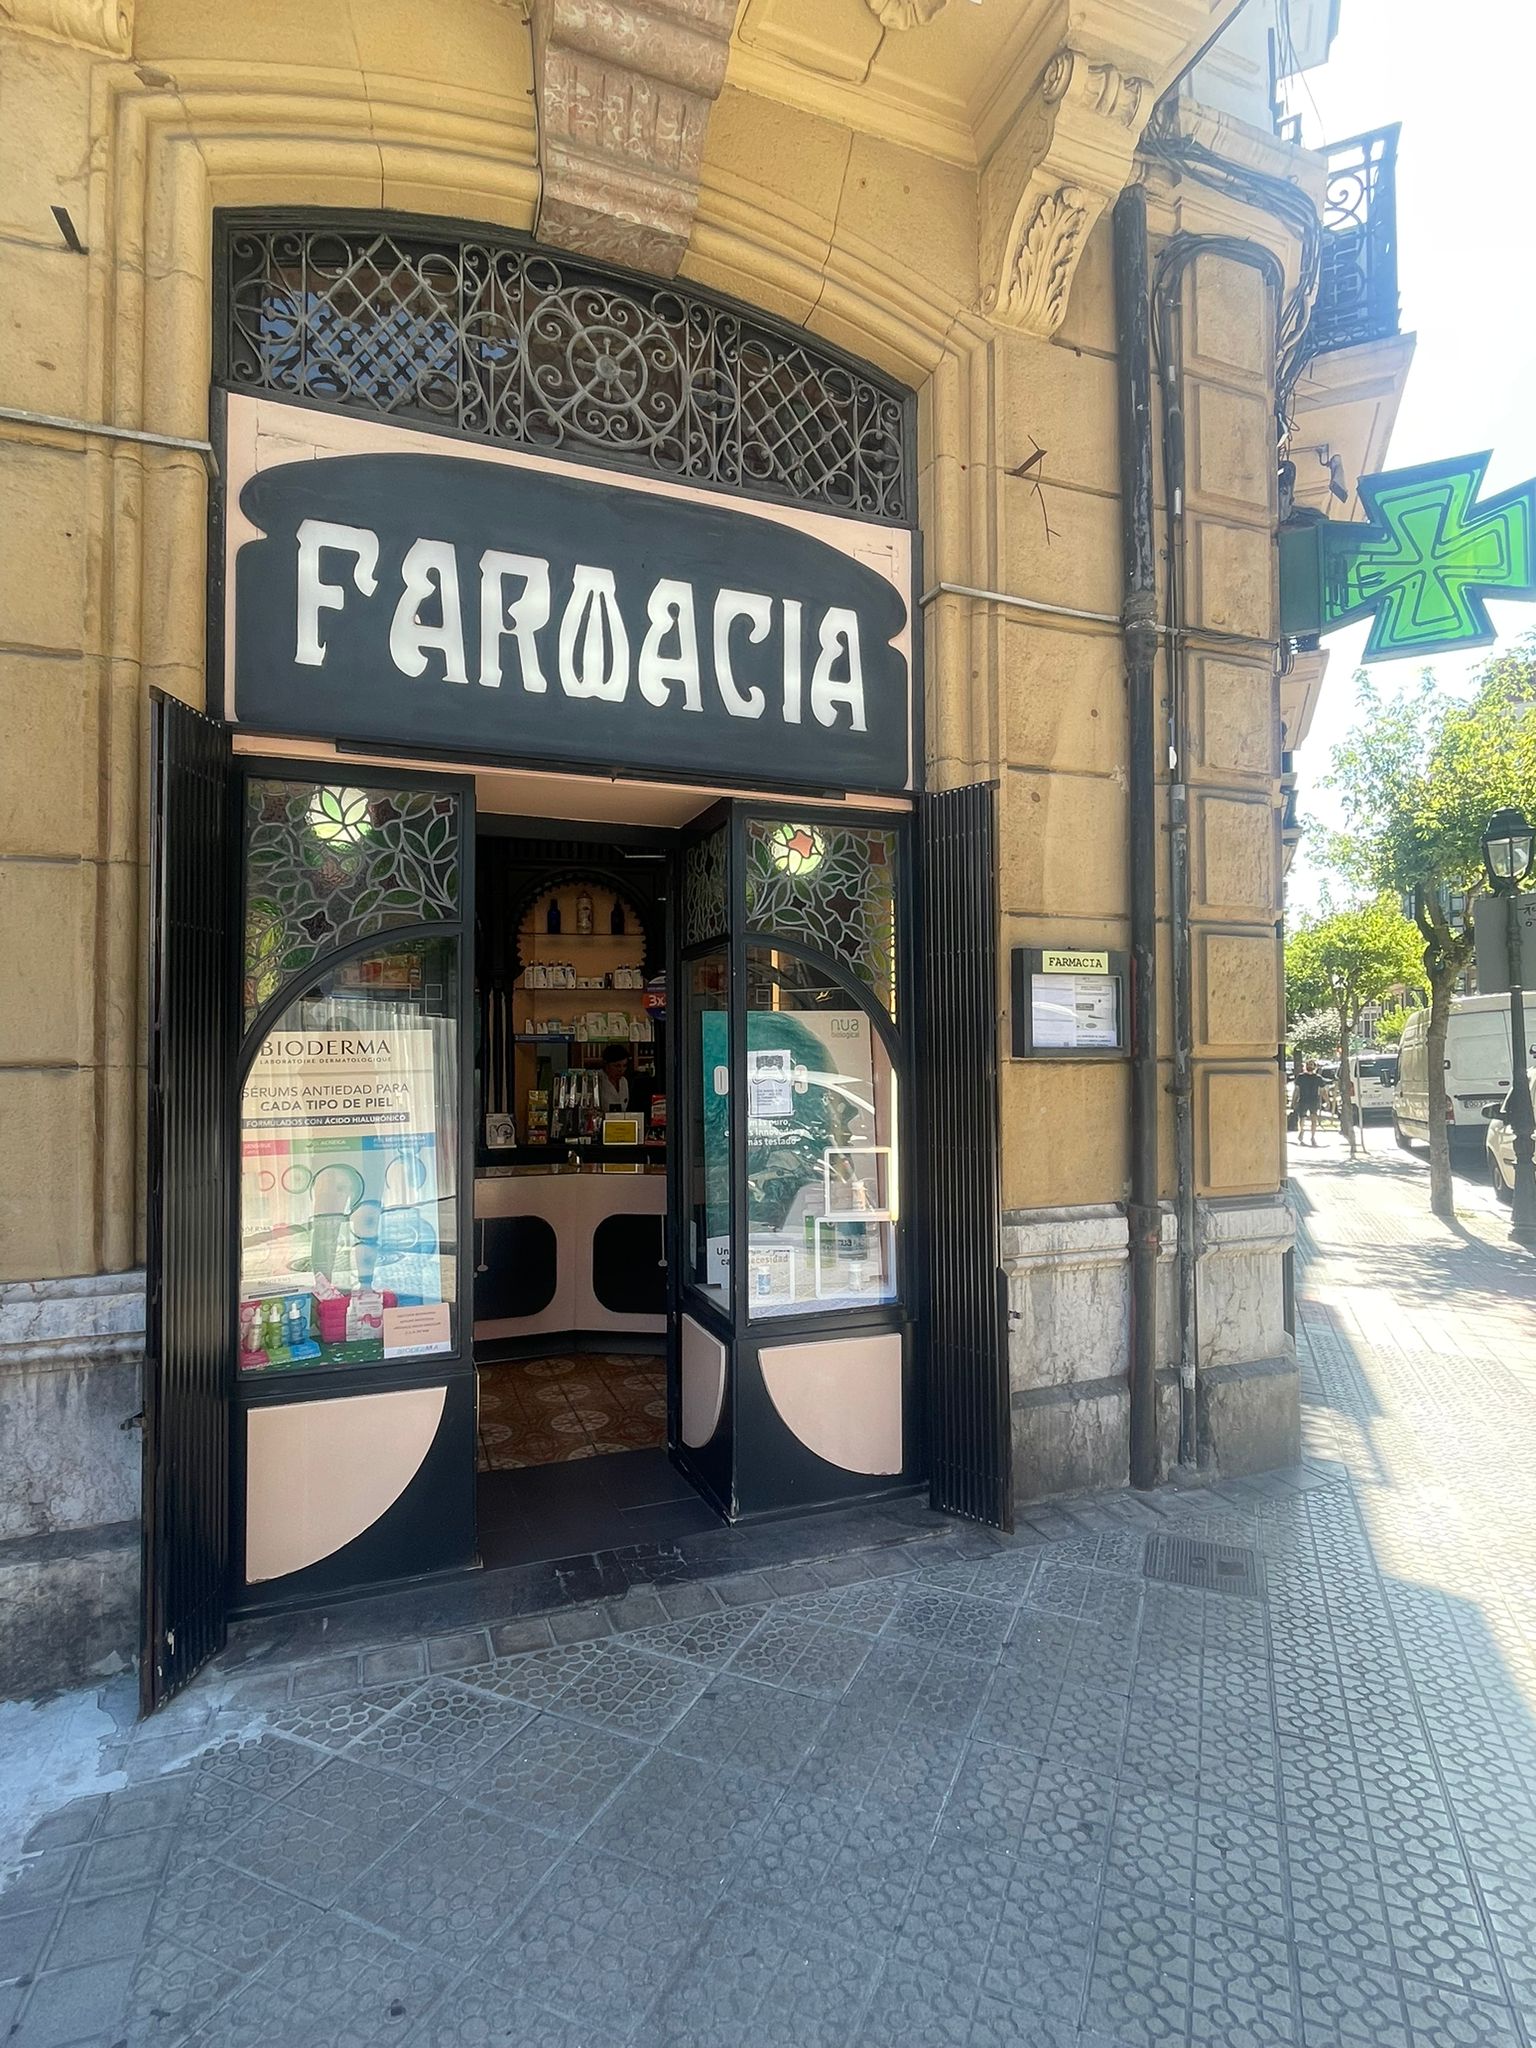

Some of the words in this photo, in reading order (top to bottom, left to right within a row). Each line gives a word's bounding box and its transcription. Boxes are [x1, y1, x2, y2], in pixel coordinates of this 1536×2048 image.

[295, 519, 868, 733] FARMACIA
[1049, 957, 1103, 968] FARMACIA
[831, 1018, 859, 1032] nua
[261, 1040, 391, 1057] BIODERMA
[260, 1057, 315, 1065] LABORATOIRE
[319, 1056, 392, 1064] DERMATOLOGIQUE
[242, 1084, 297, 1098] SÉRUMS
[301, 1084, 372, 1097] ANTIEDAD
[376, 1082, 409, 1094] PARA
[260, 1100, 302, 1112] CADA
[306, 1099, 338, 1110] TIPO
[343, 1098, 361, 1109] DE
[365, 1097, 393, 1108] PIEL
[246, 1117, 303, 1128] FORMULADOS
[304, 1117, 323, 1127] CON
[324, 1115, 351, 1125] ÁCIDO
[352, 1114, 406, 1124] HIALURÓNICO
